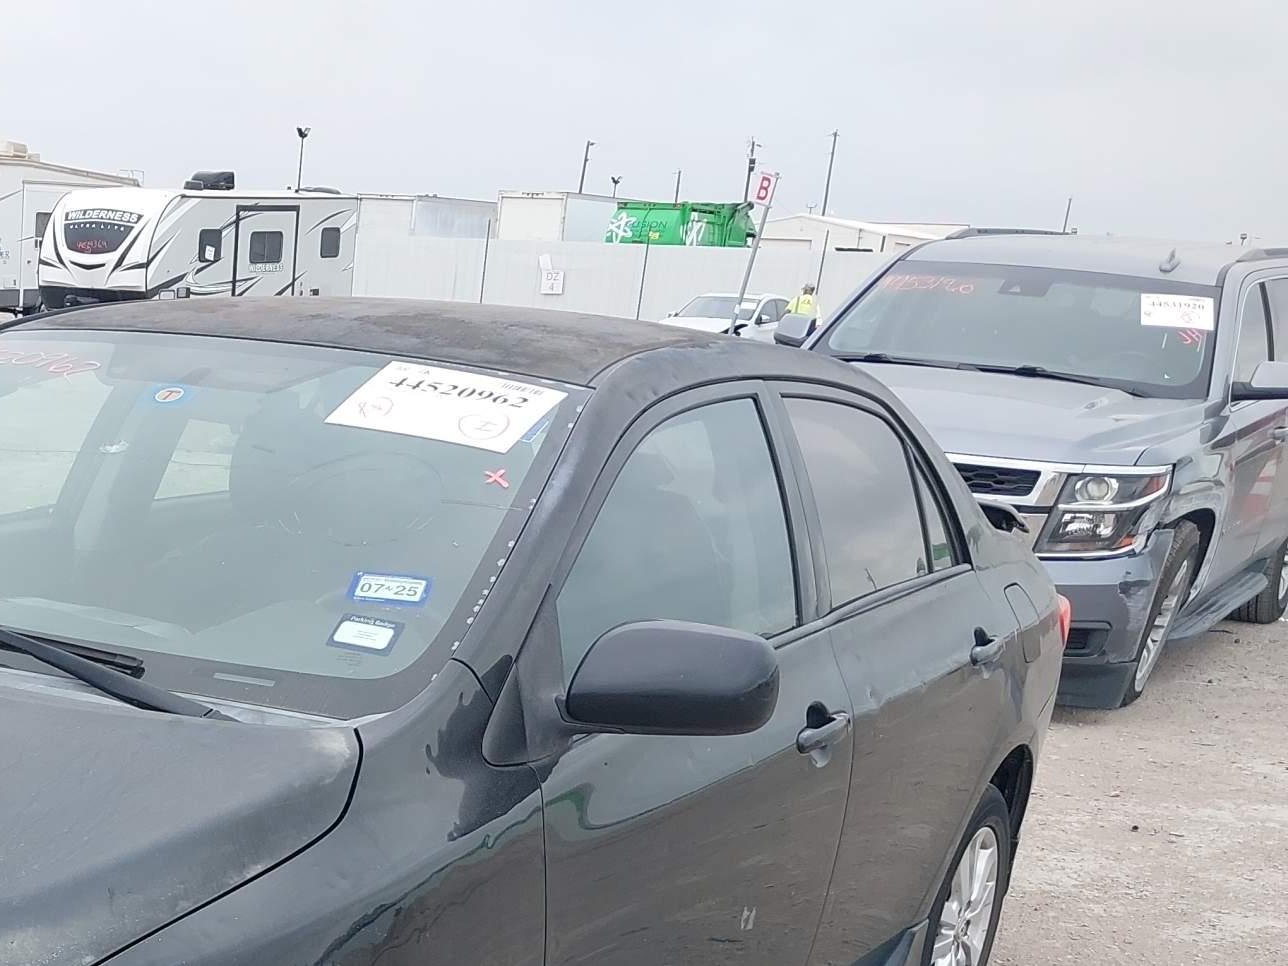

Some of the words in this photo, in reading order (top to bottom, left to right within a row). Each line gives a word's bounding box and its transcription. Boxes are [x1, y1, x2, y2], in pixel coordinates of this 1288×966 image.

[756, 176, 772, 201] B
[67, 209, 139, 223] WILDERNESS
[389, 376, 530, 410] 44520962
